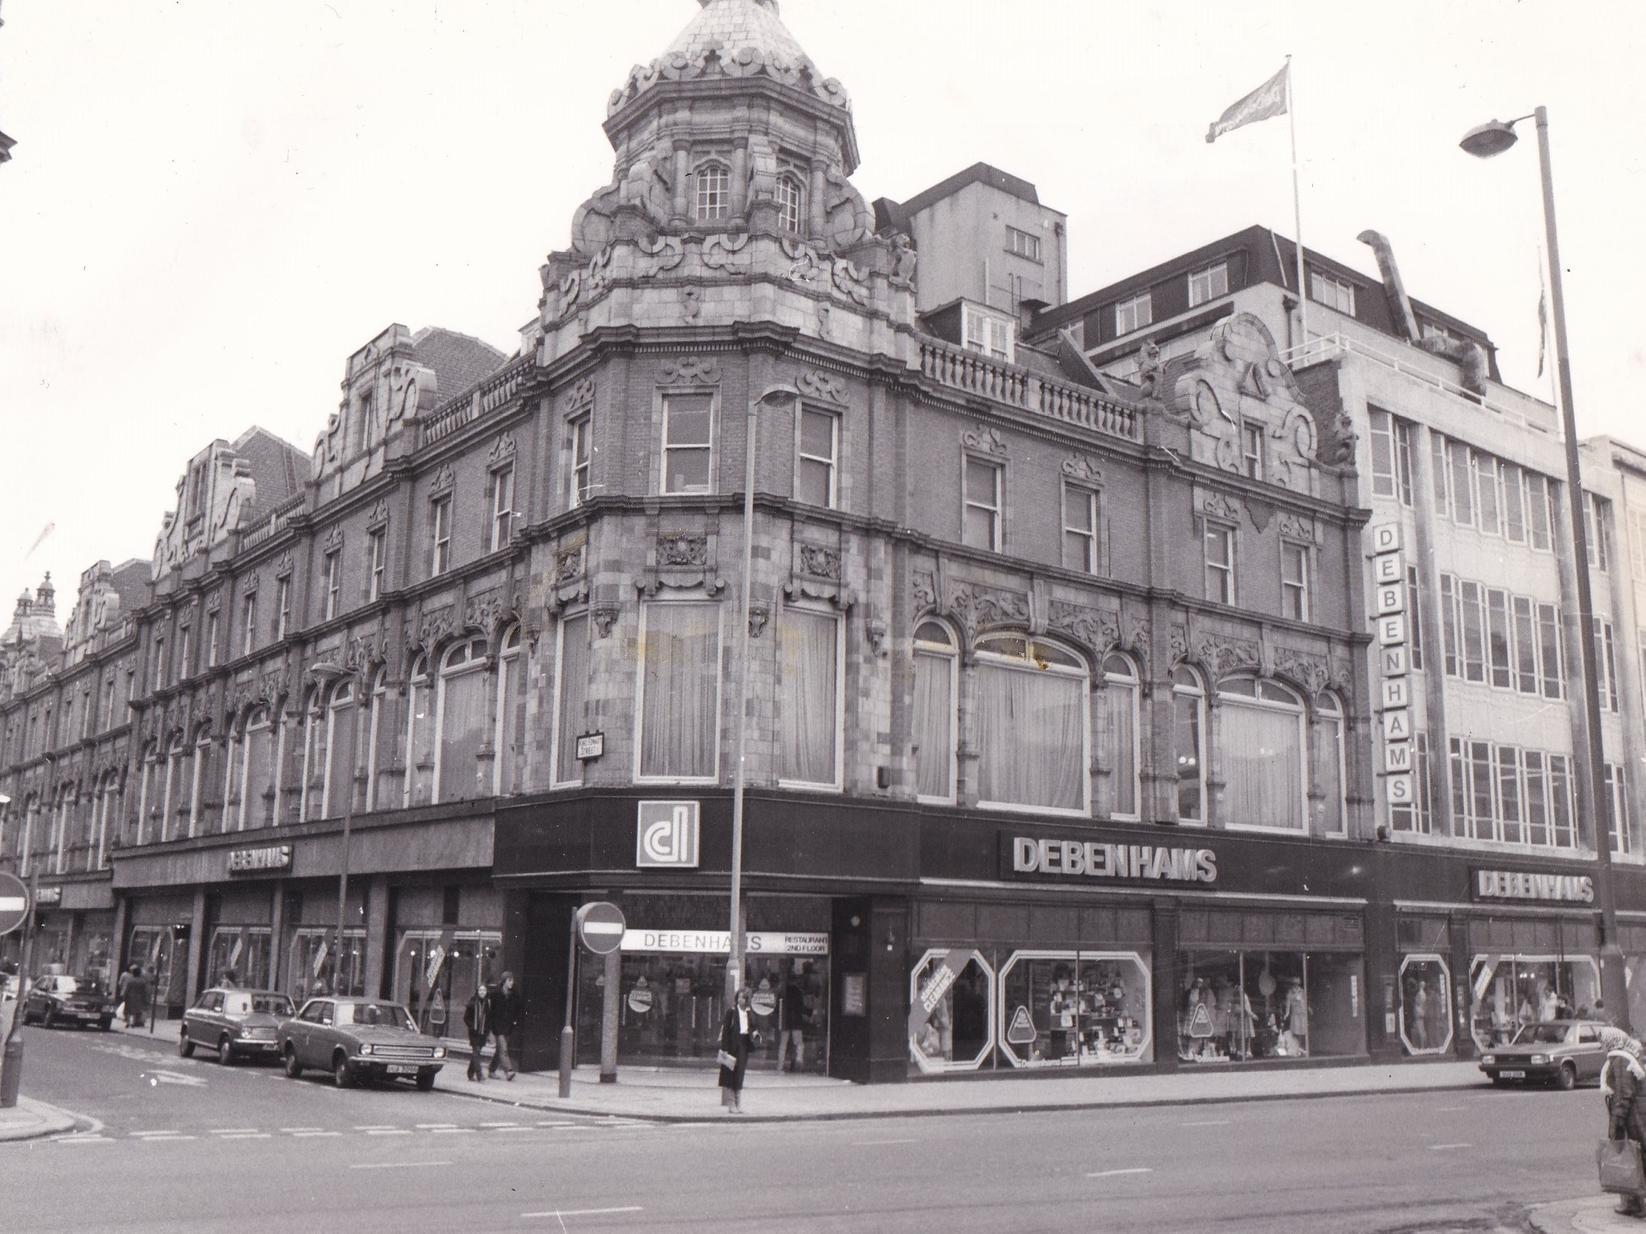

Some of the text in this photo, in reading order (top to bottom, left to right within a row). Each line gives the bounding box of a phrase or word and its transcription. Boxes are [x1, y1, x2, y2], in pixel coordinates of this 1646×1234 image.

[1380, 530, 1406, 799] DEBENHAMS
[1013, 837, 1218, 882] DEBENHAMS
[1478, 870, 1594, 902] DEBENHAMS
[644, 933, 762, 950] DEBENHAS
[784, 936, 828, 944] RESTAURANT
[803, 945, 825, 953] FLOOR
